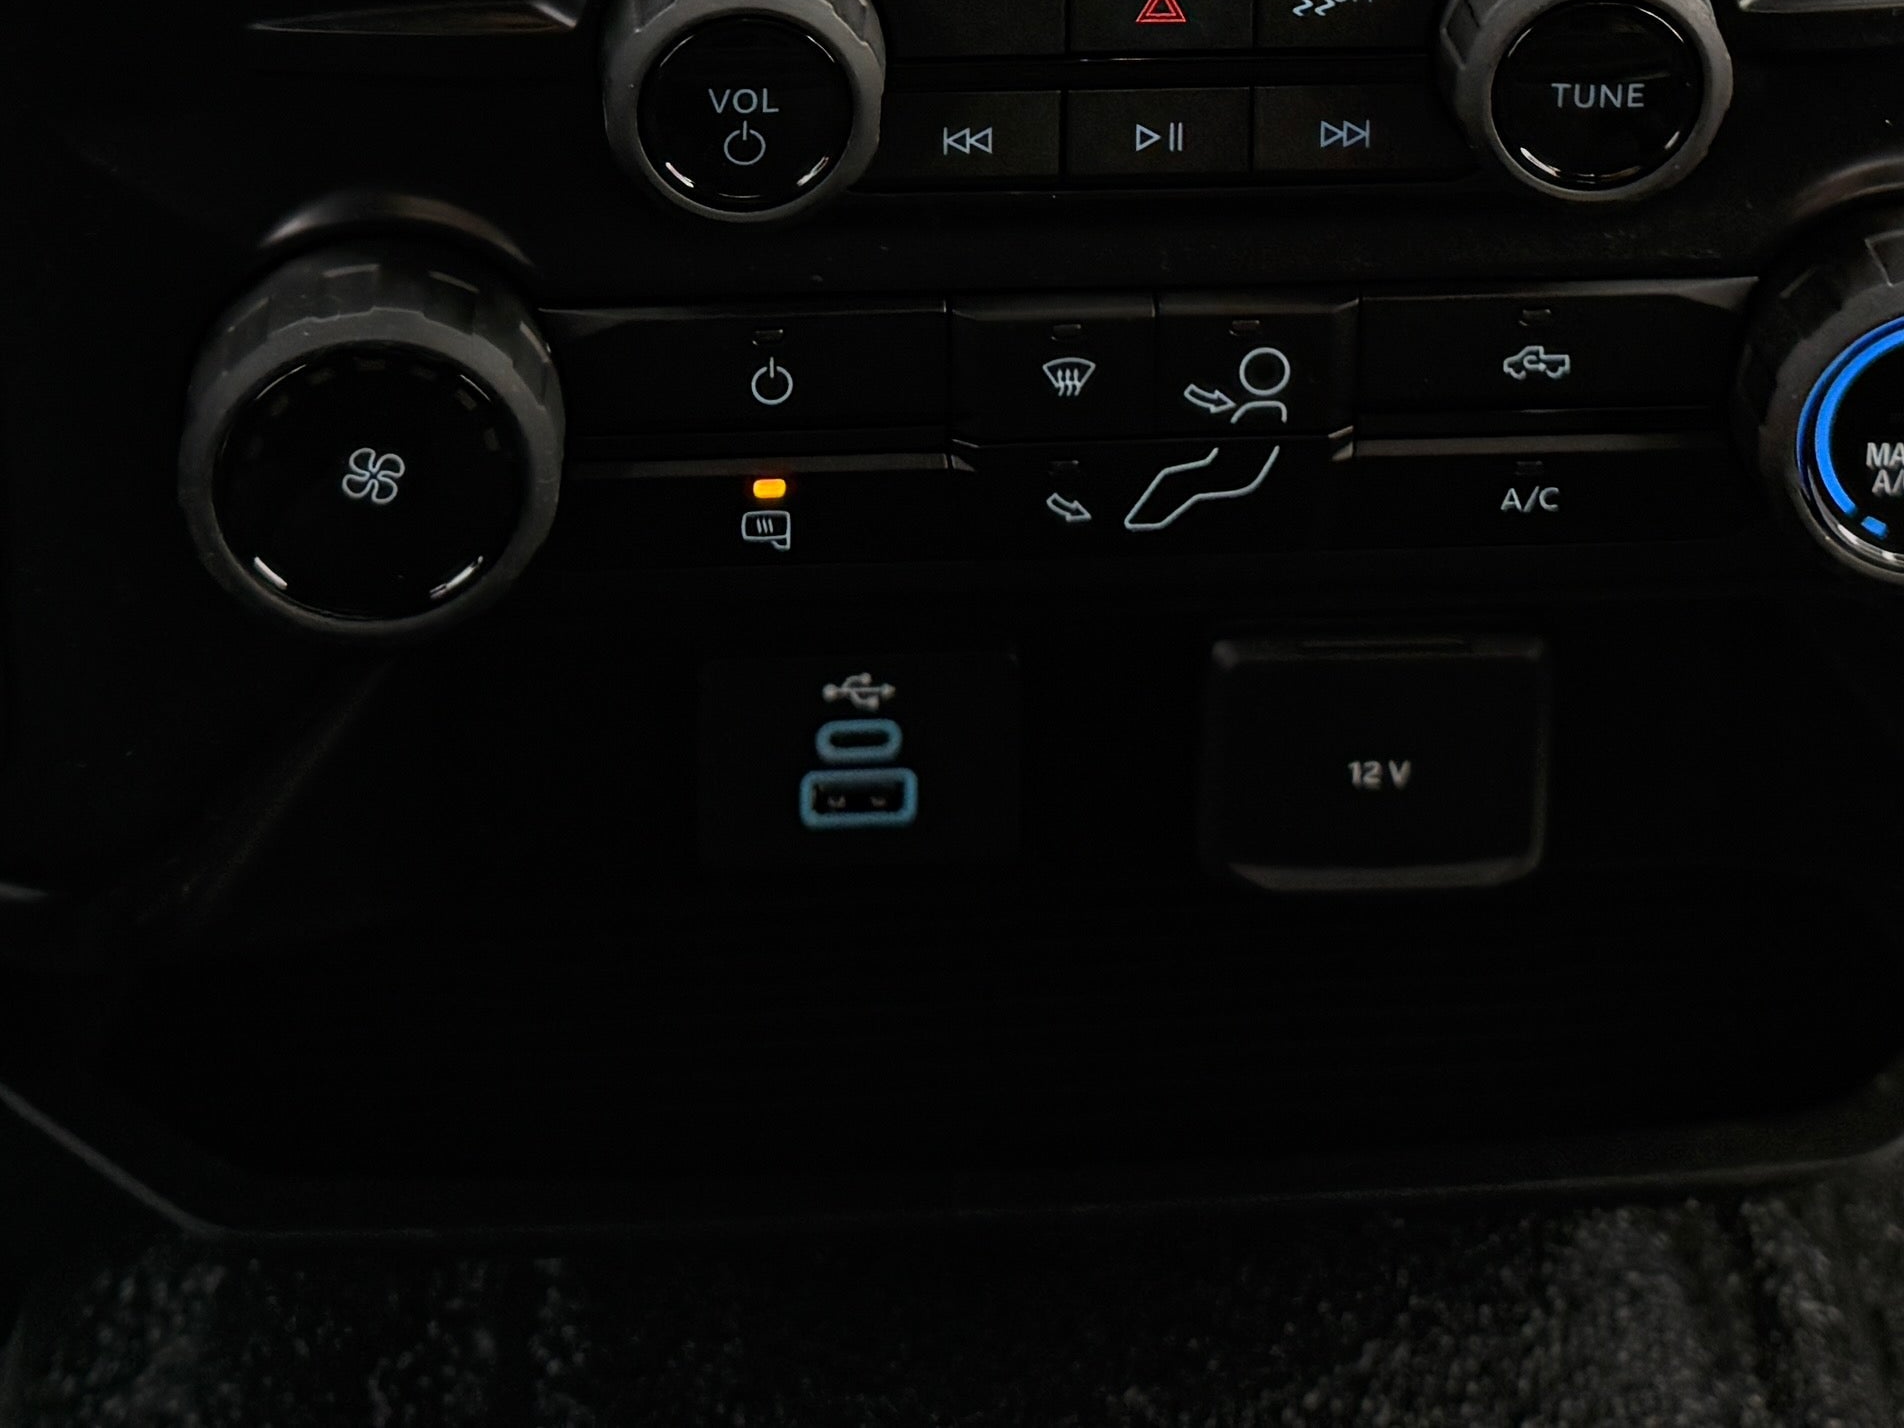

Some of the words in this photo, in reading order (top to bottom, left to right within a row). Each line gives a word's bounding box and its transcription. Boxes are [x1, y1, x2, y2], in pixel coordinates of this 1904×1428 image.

[709, 88, 779, 113] VOL
[1551, 83, 1644, 108] TUNE
[1501, 486, 1559, 512] A/C
[1349, 761, 1381, 787] 12
[1389, 760, 1410, 786] V
